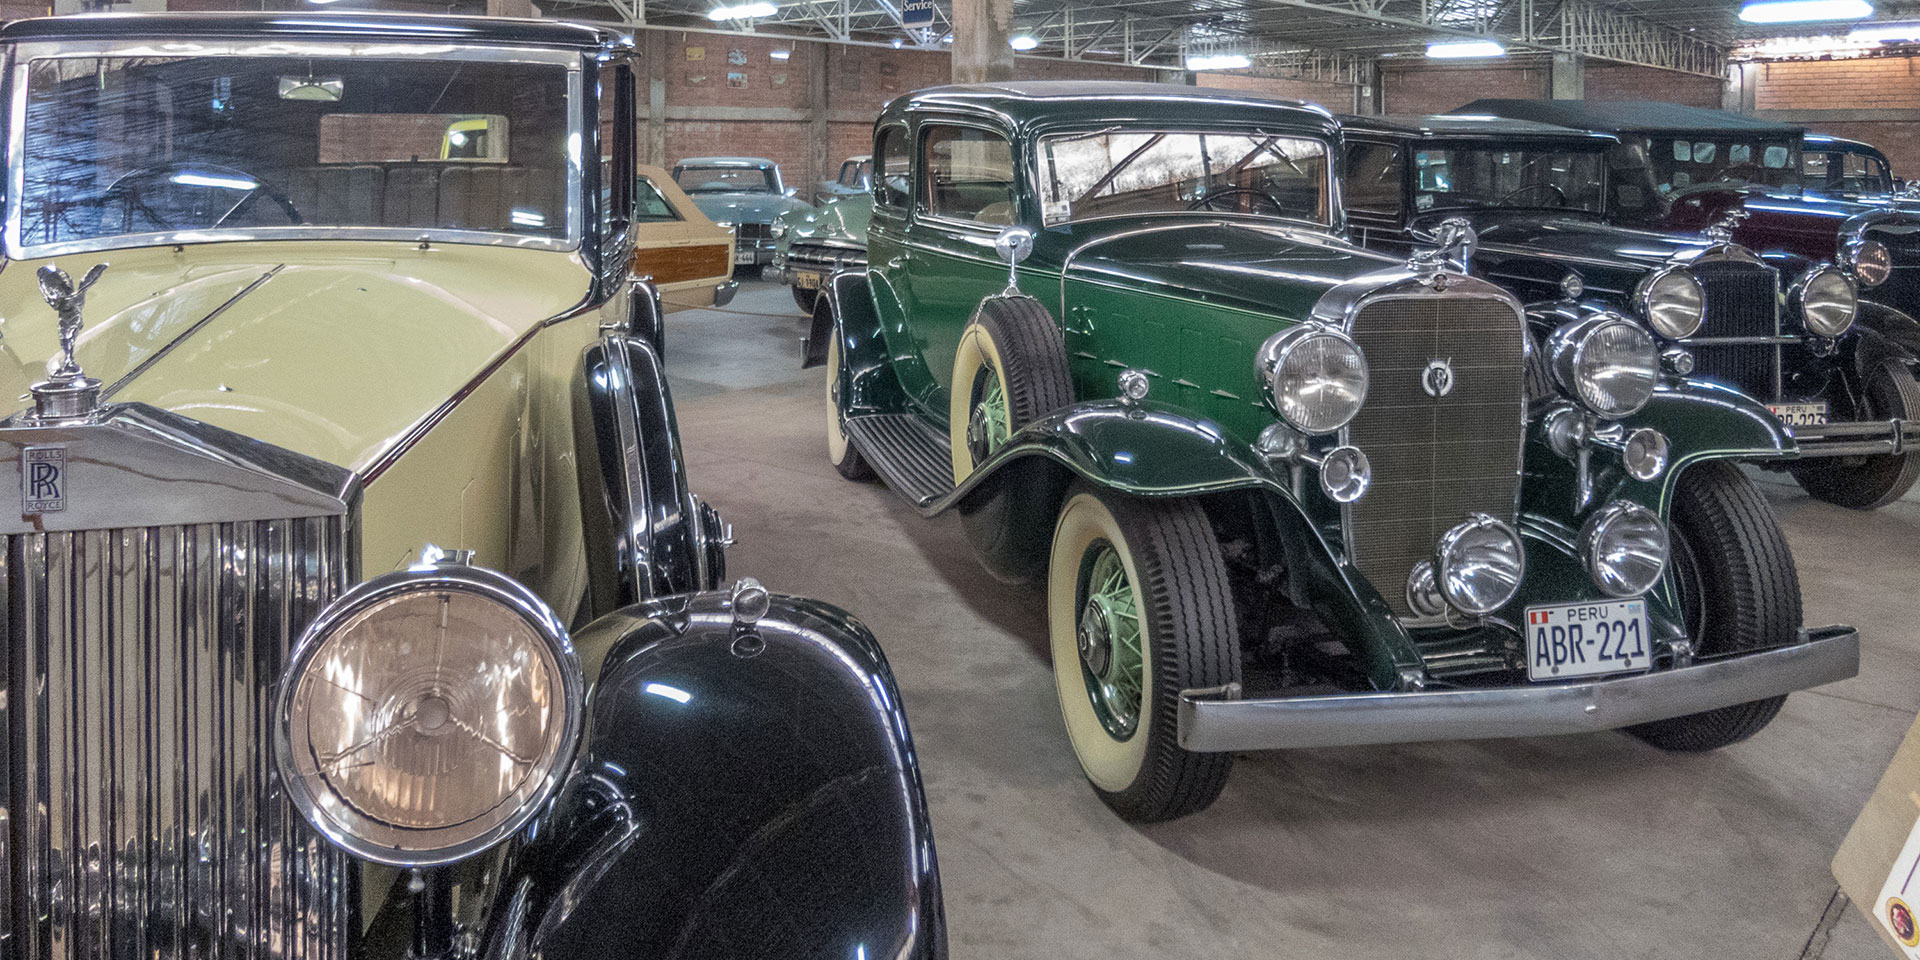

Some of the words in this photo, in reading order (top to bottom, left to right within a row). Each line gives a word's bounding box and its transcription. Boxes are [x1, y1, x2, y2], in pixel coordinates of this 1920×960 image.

[904, 0, 932, 11] Service
[1785, 405, 1807, 413] PERU
[28, 450, 62, 459] ROLLS
[27, 501, 62, 510] ROYCE
[1567, 606, 1609, 622] PERU
[1536, 618, 1645, 667] ABR-221
